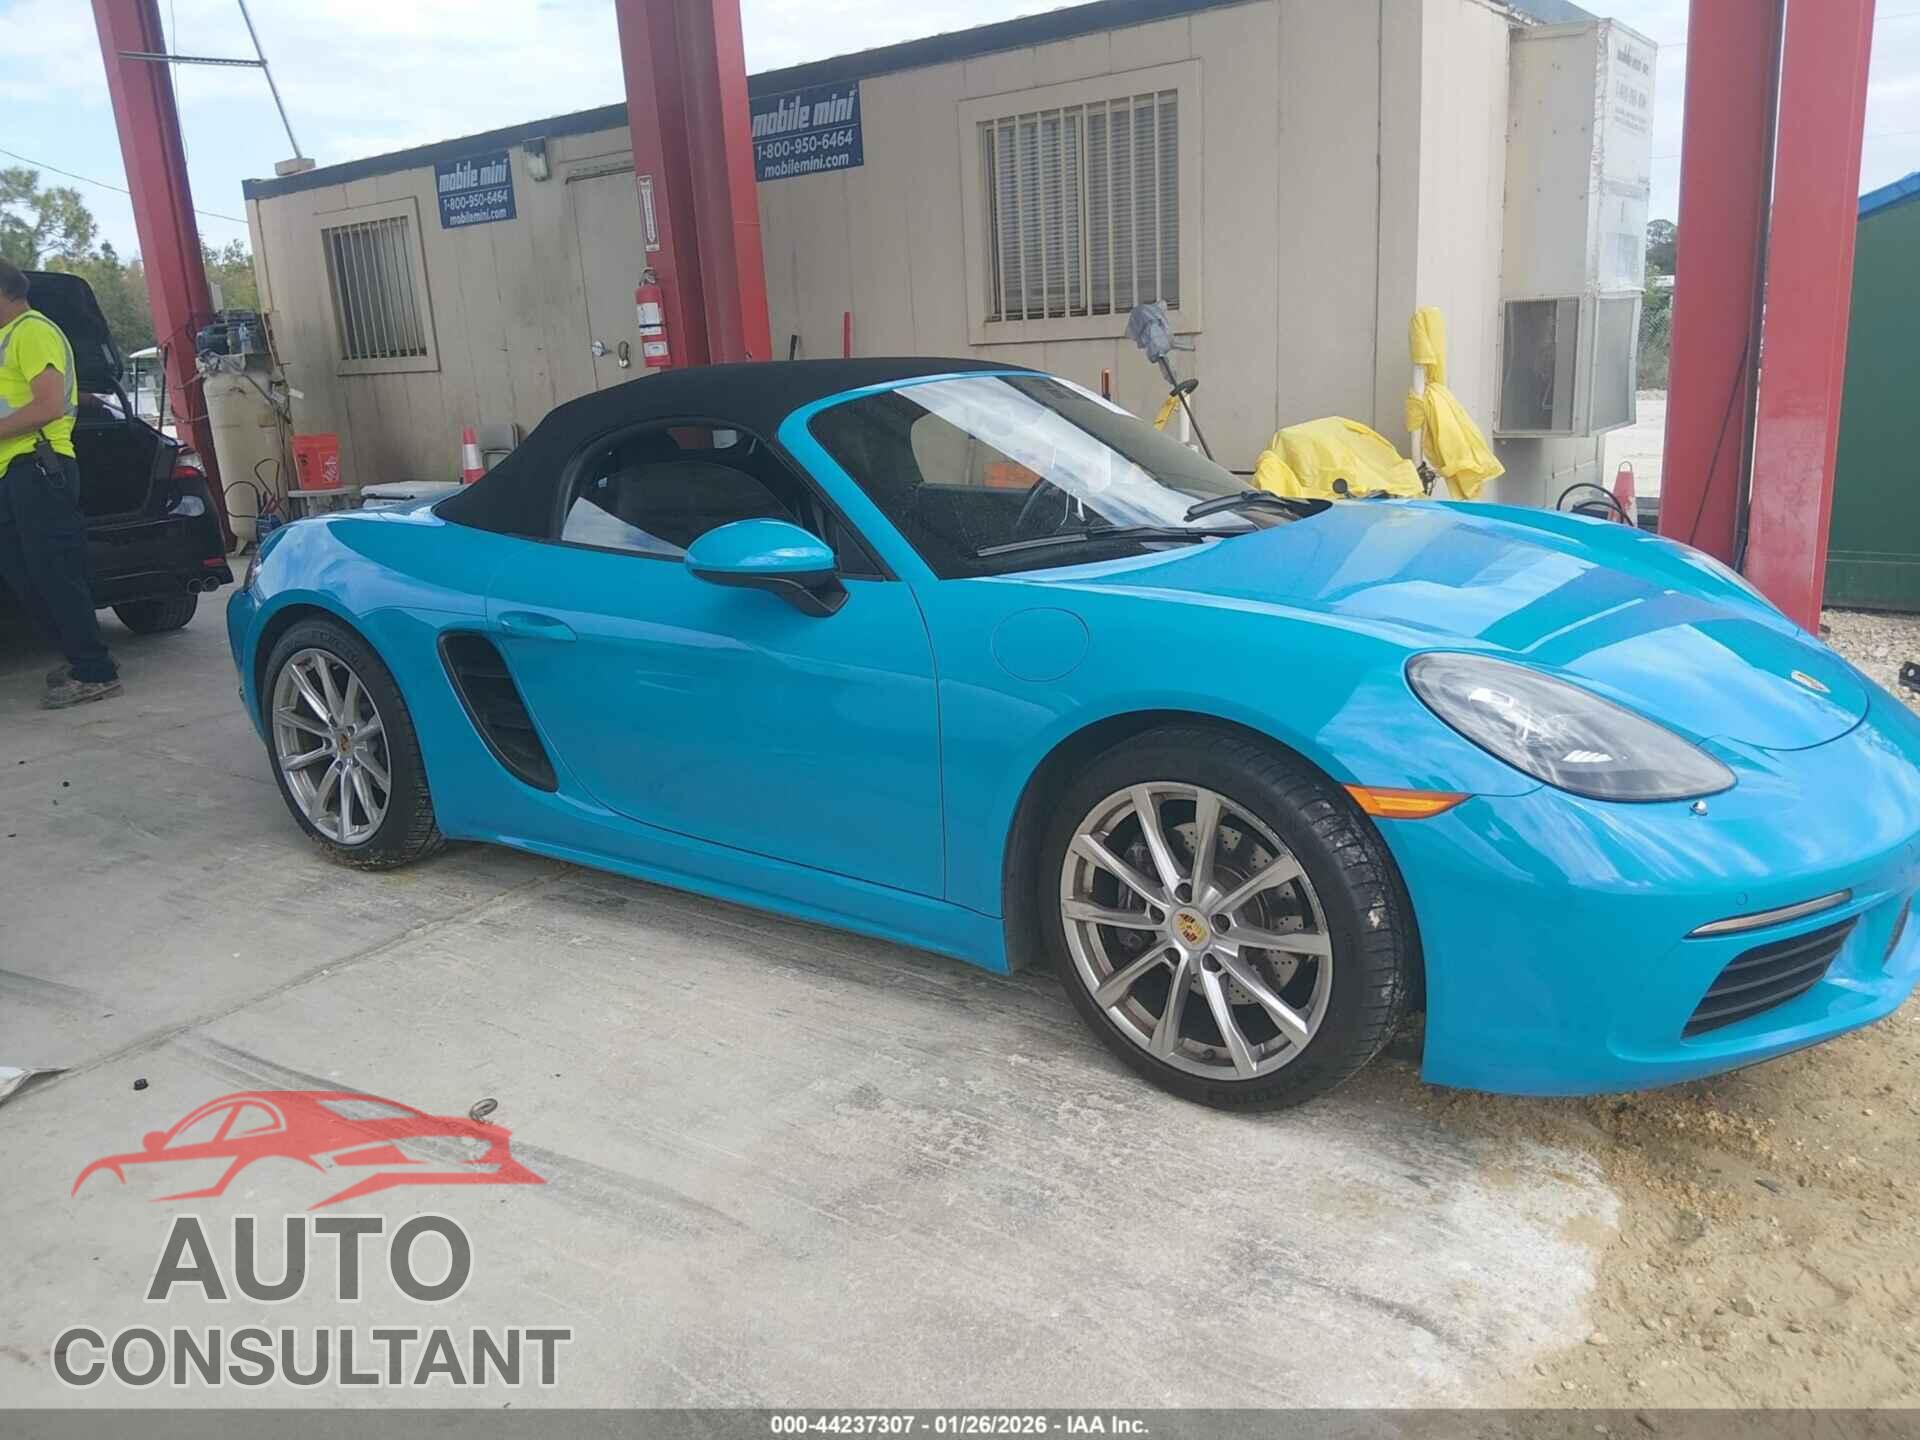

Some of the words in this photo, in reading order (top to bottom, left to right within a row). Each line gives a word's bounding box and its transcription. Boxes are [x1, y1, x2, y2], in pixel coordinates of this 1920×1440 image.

[752, 95, 810, 138] mobile
[813, 90, 857, 126] mini
[757, 129, 853, 160] 1-800-950-6464
[439, 160, 479, 192] mobile
[480, 158, 508, 185] mini
[765, 153, 849, 177] mobilemini.com
[444, 190, 508, 211] 1-800-950-6464
[450, 208, 507, 225] mobilemini.com
